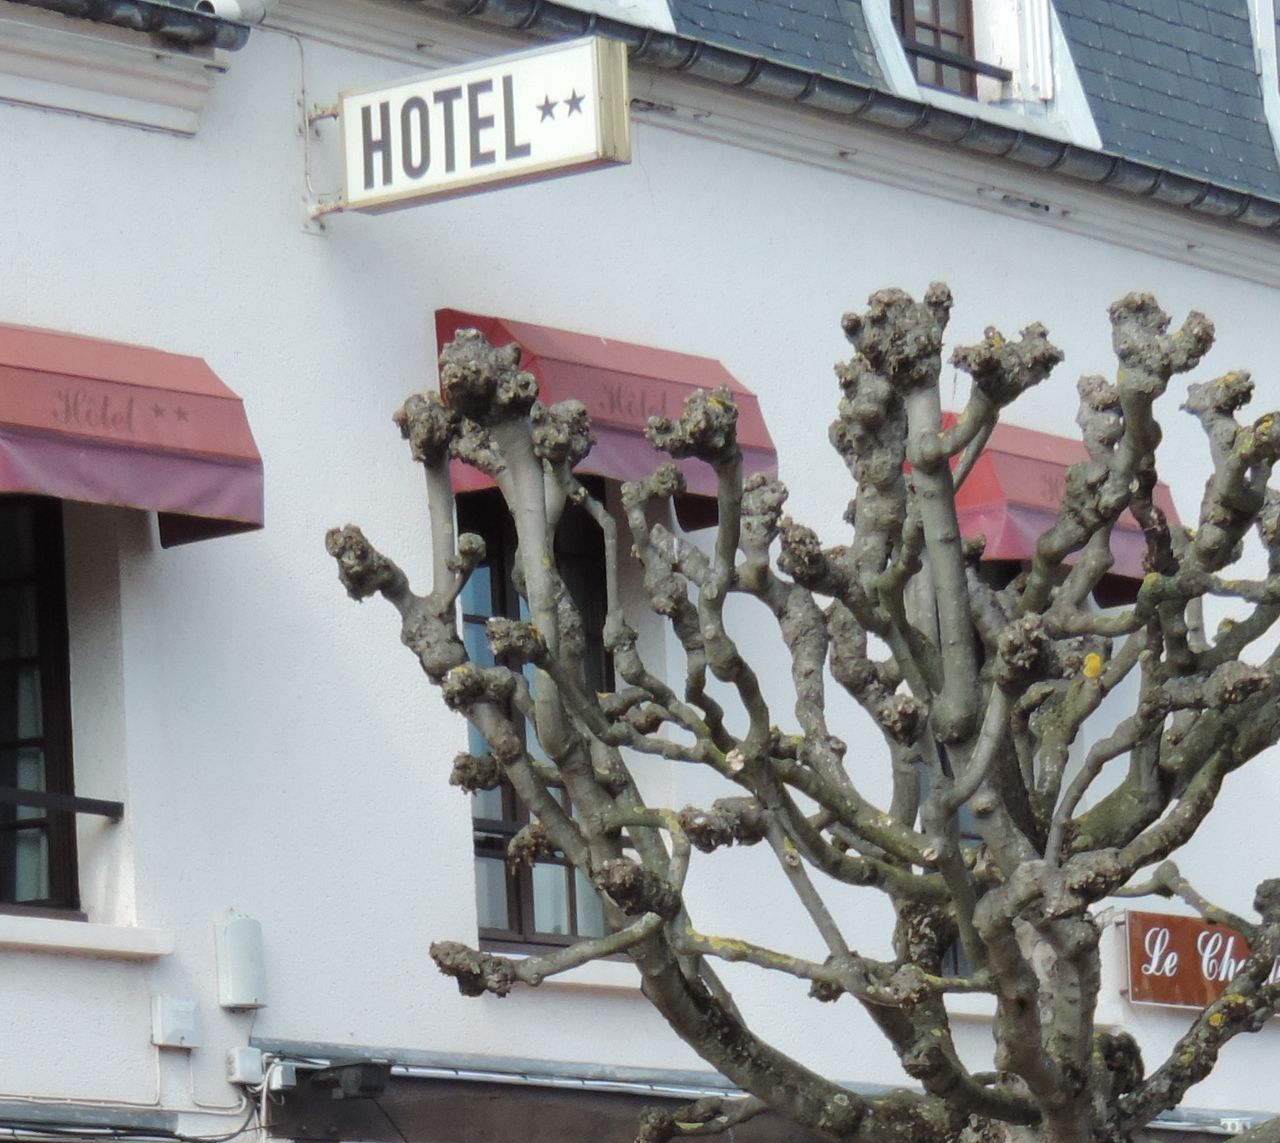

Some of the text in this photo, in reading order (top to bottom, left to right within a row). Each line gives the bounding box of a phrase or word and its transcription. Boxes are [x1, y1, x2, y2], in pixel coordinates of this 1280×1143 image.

[361, 75, 531, 190] HOTEL
[52, 390, 136, 433] Hôtel
[1141, 927, 1178, 978] Le
